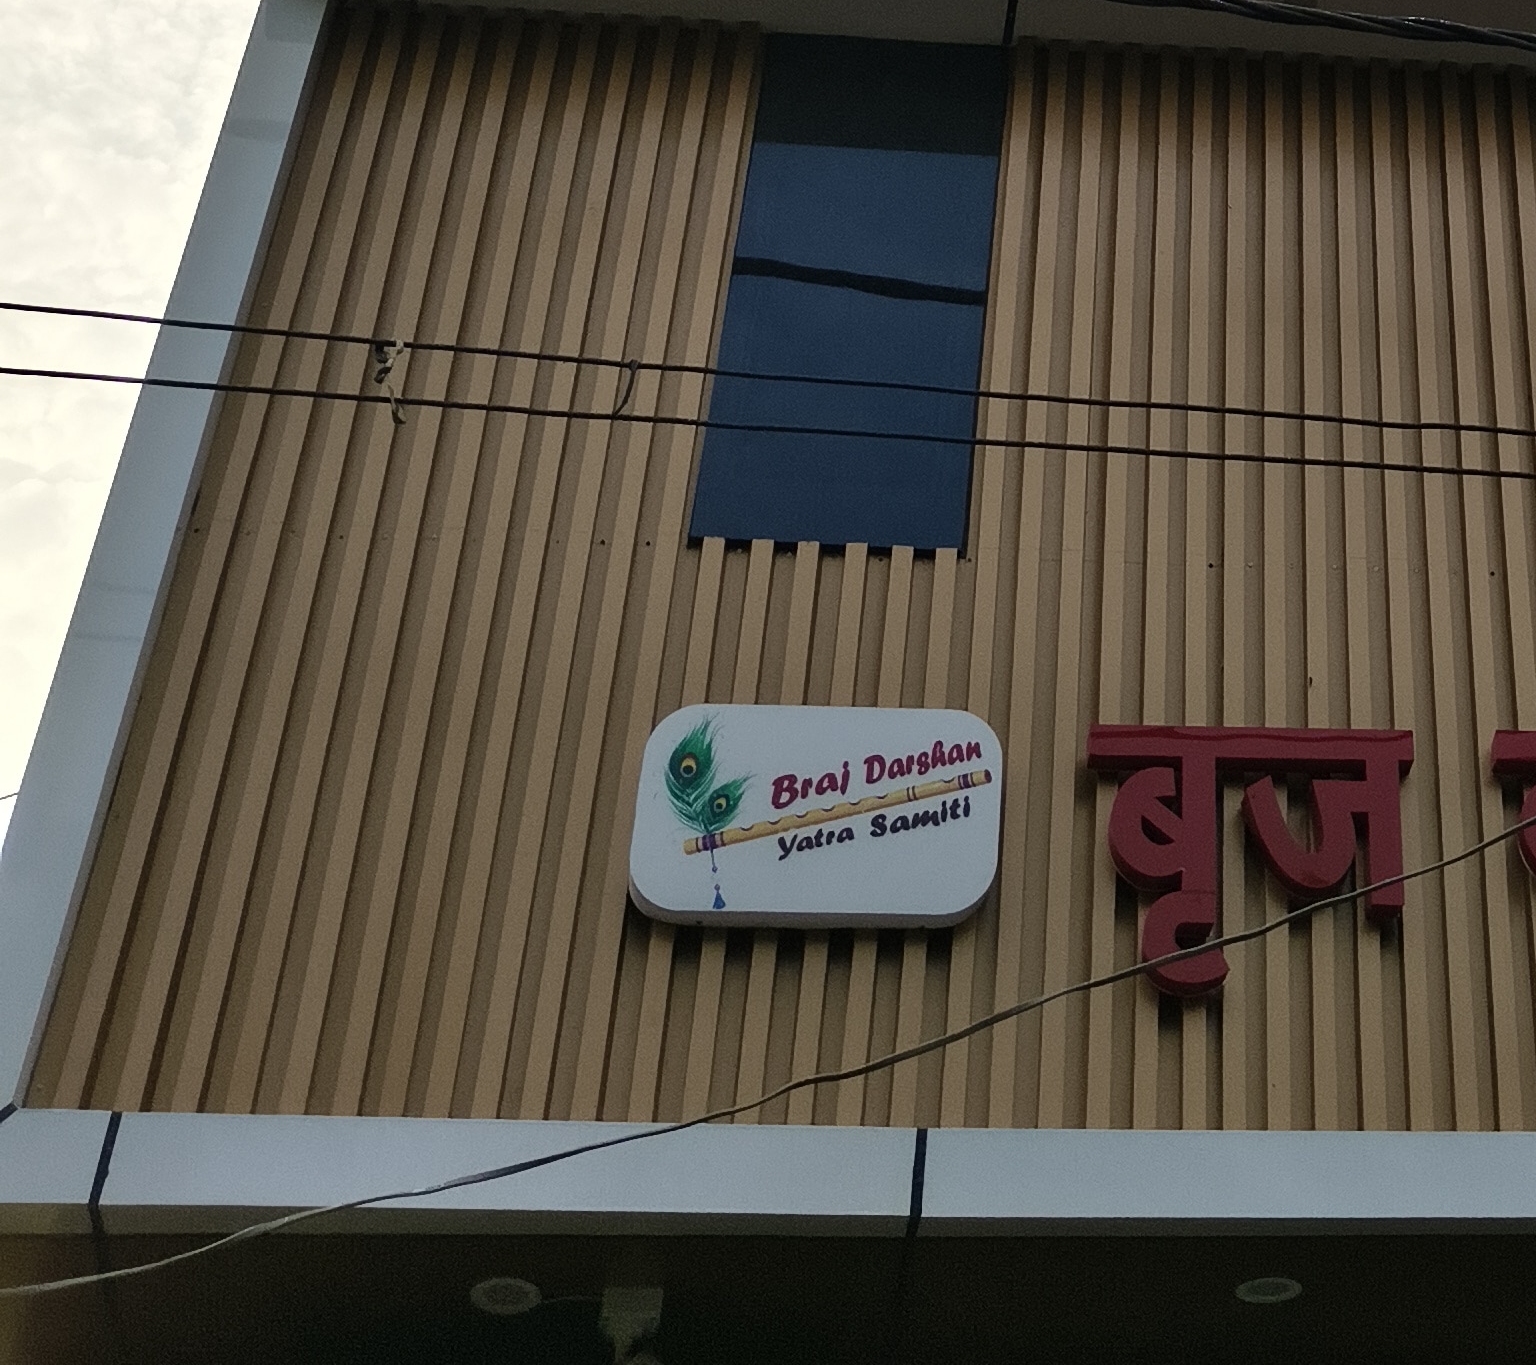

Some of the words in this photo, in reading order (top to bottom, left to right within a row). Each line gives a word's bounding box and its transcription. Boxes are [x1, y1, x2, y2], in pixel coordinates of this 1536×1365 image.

[771, 760, 850, 810] Braj
[863, 740, 982, 785] Darshan
[869, 795, 971, 838] Samiti
[1087, 724, 1415, 997] बृज
